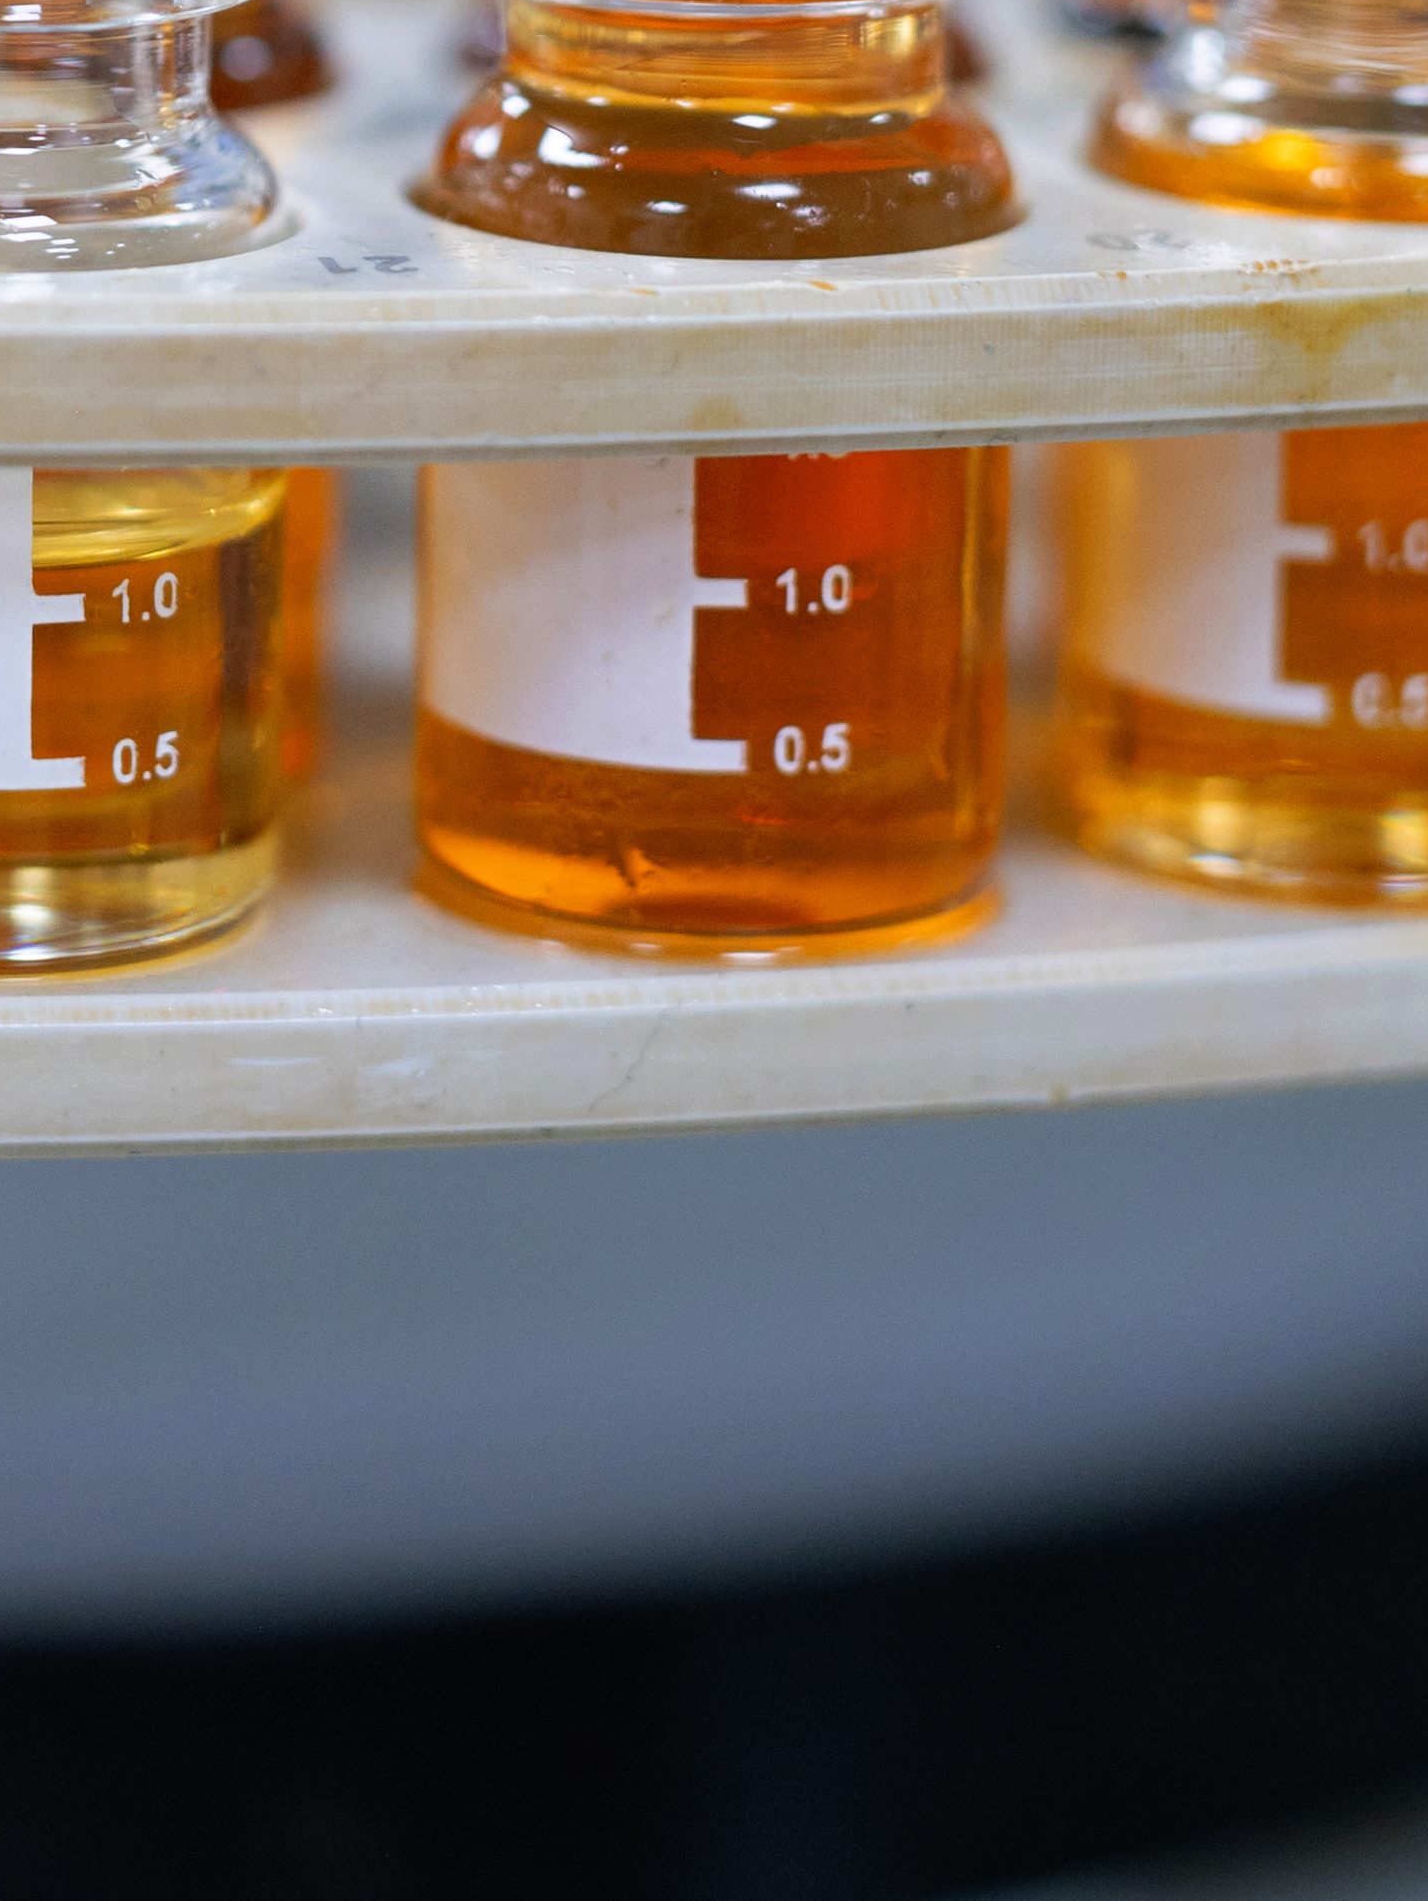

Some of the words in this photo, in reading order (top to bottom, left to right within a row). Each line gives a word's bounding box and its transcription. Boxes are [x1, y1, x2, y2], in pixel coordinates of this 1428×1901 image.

[111, 571, 179, 624] 1.0
[774, 562, 854, 615] 1.0
[111, 729, 180, 785] 0.5
[773, 721, 853, 776] 0.5
